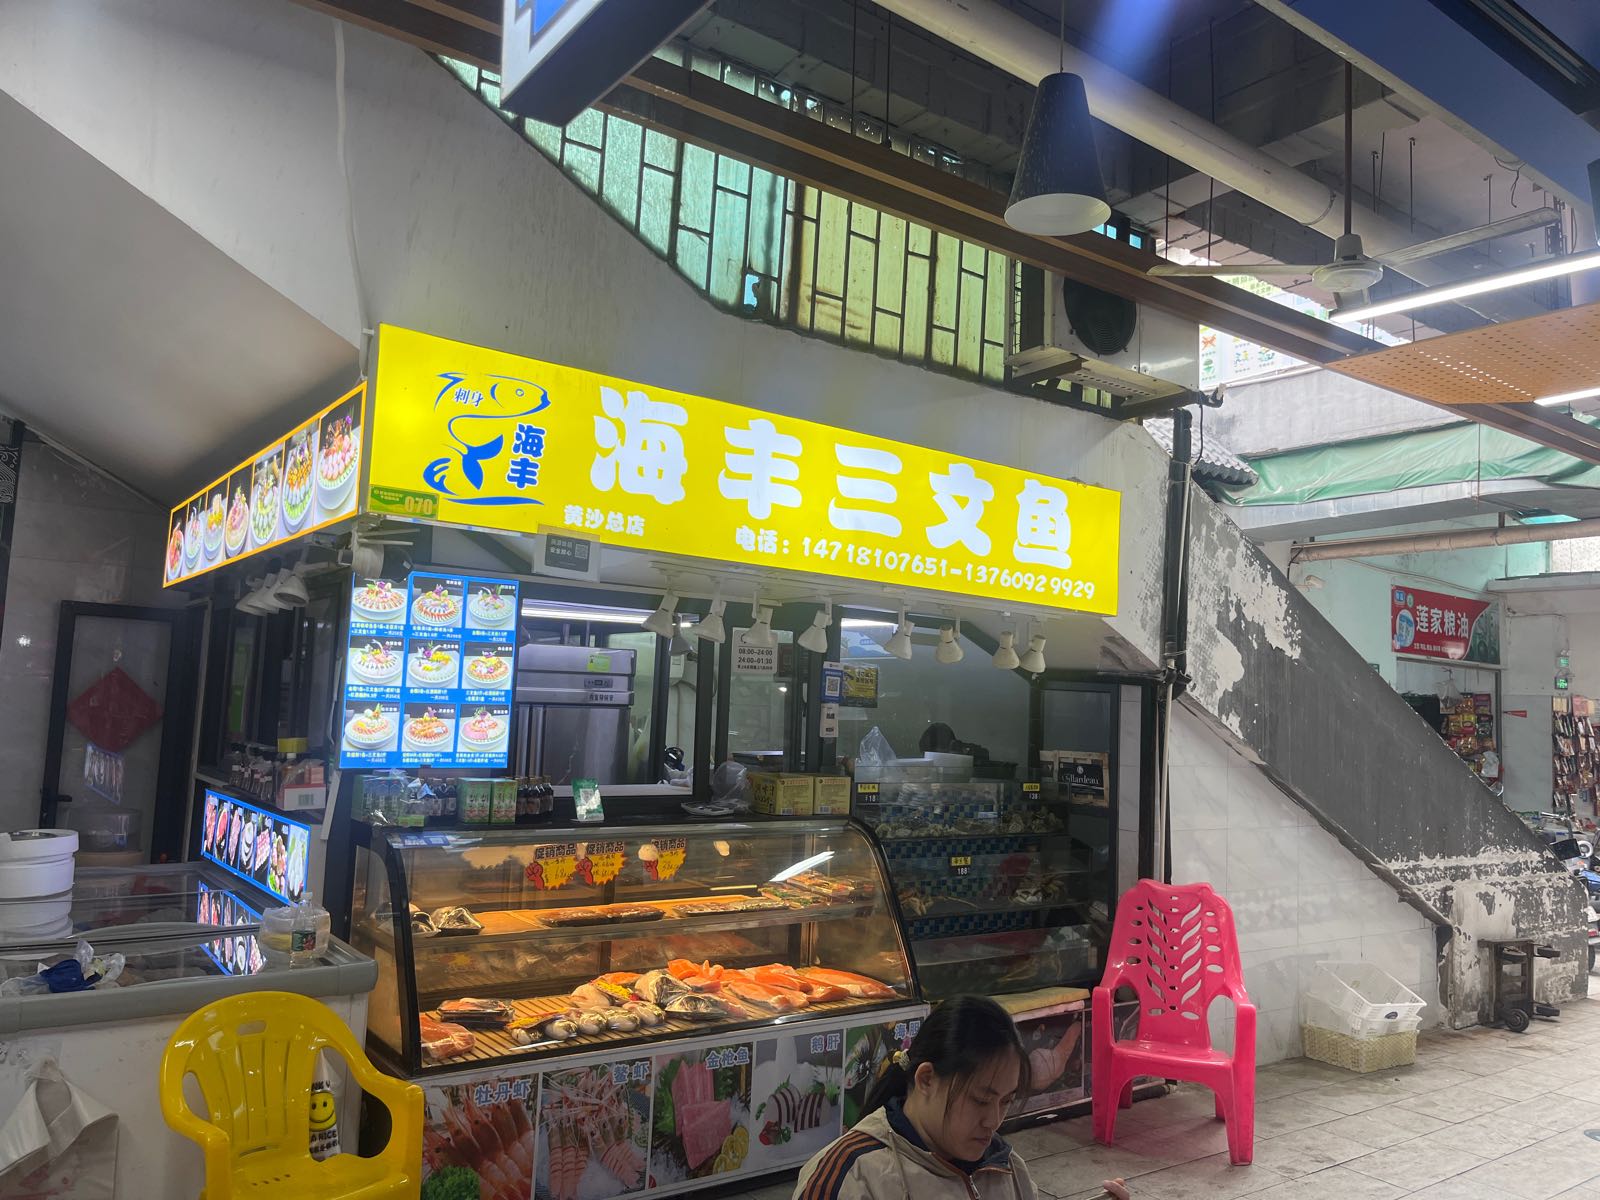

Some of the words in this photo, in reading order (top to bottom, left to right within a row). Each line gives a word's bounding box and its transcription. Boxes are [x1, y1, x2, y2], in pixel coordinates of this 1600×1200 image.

[454, 388, 484, 406] 刺身
[507, 423, 546, 489] 海丰
[590, 386, 1073, 569] 海丰三文鱼
[405, 496, 433, 515] 070
[563, 505, 646, 537] 黄沙总店
[1416, 605, 1470, 639] 莲家粮油
[536, 843, 577, 859] 促销商品
[810, 1033, 841, 1054] 鹅肝
[705, 1046, 750, 1069] 金枪鱼
[474, 1078, 532, 1107] 牡丹虾
